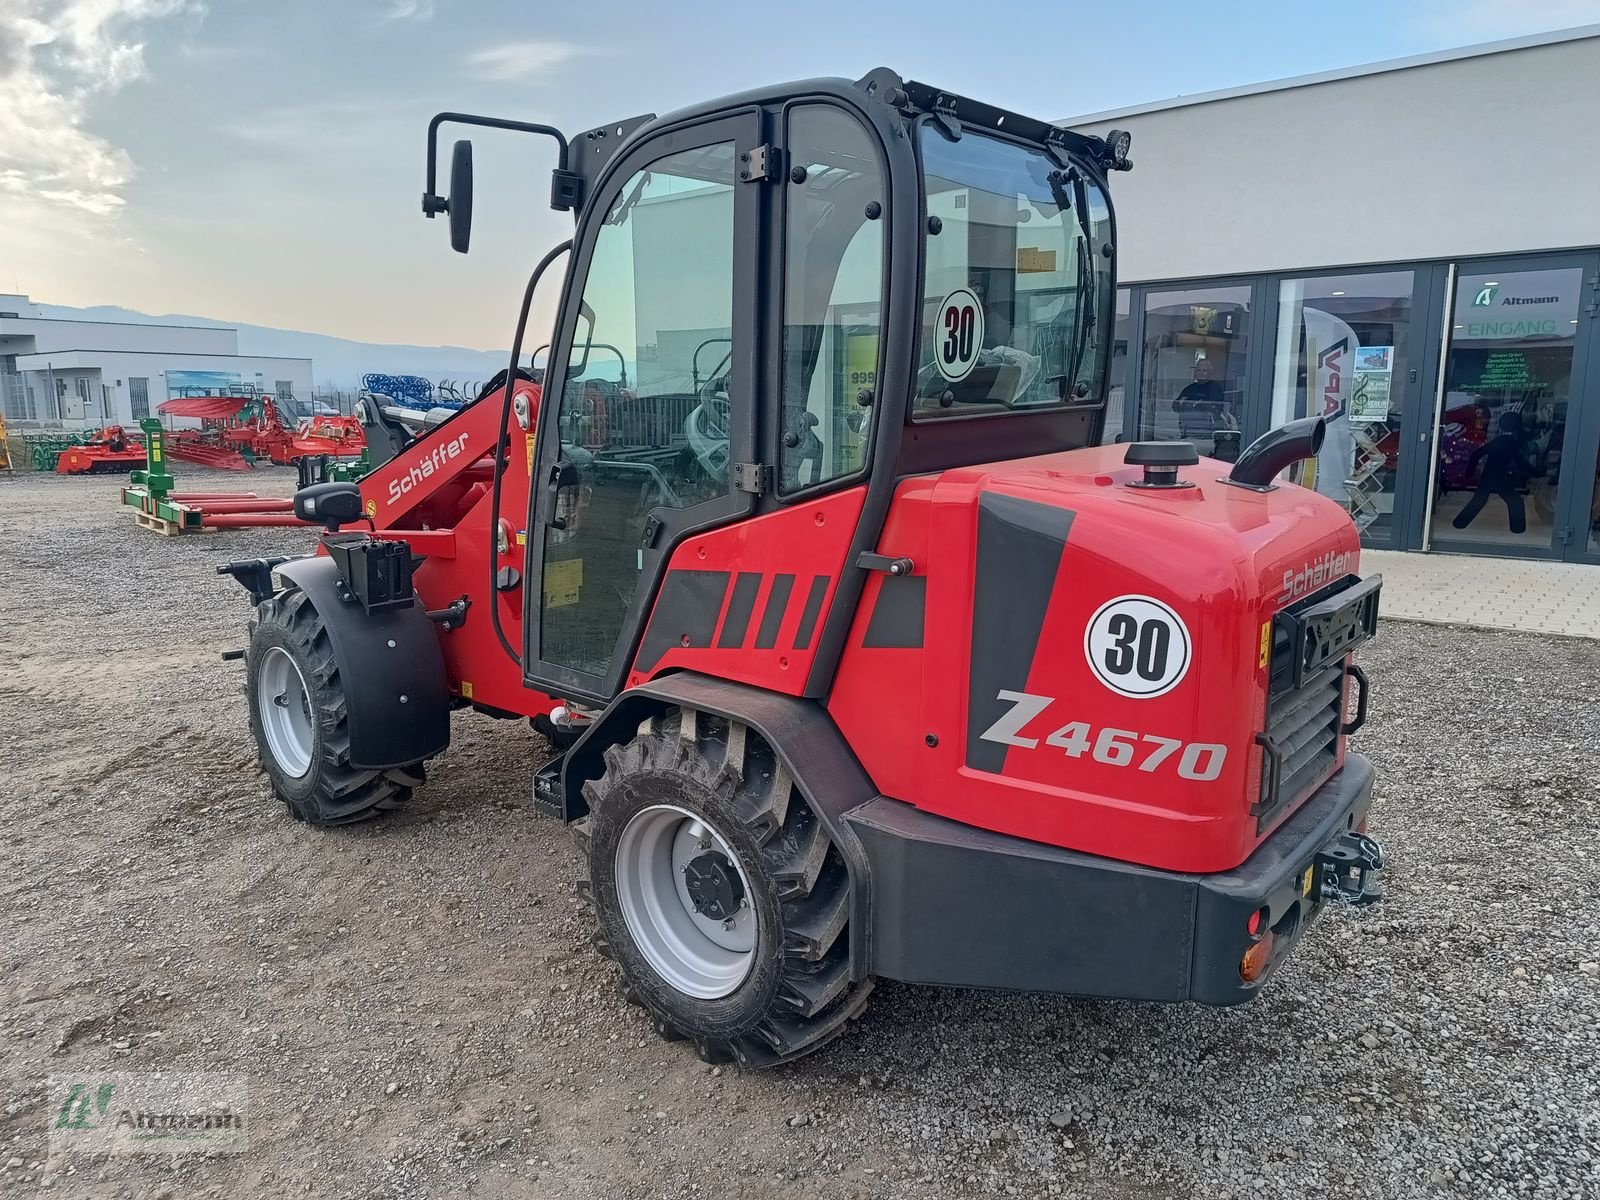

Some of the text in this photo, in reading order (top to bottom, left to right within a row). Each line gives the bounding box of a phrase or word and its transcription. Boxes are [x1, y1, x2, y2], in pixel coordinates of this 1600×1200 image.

[1468, 321, 1556, 337] EINGANG
[1502, 296, 1559, 306] Altmann
[944, 305, 974, 364] 30
[387, 432, 469, 506] Schäffer
[1278, 550, 1351, 605] Schäffer
[1105, 614, 1171, 682] 30
